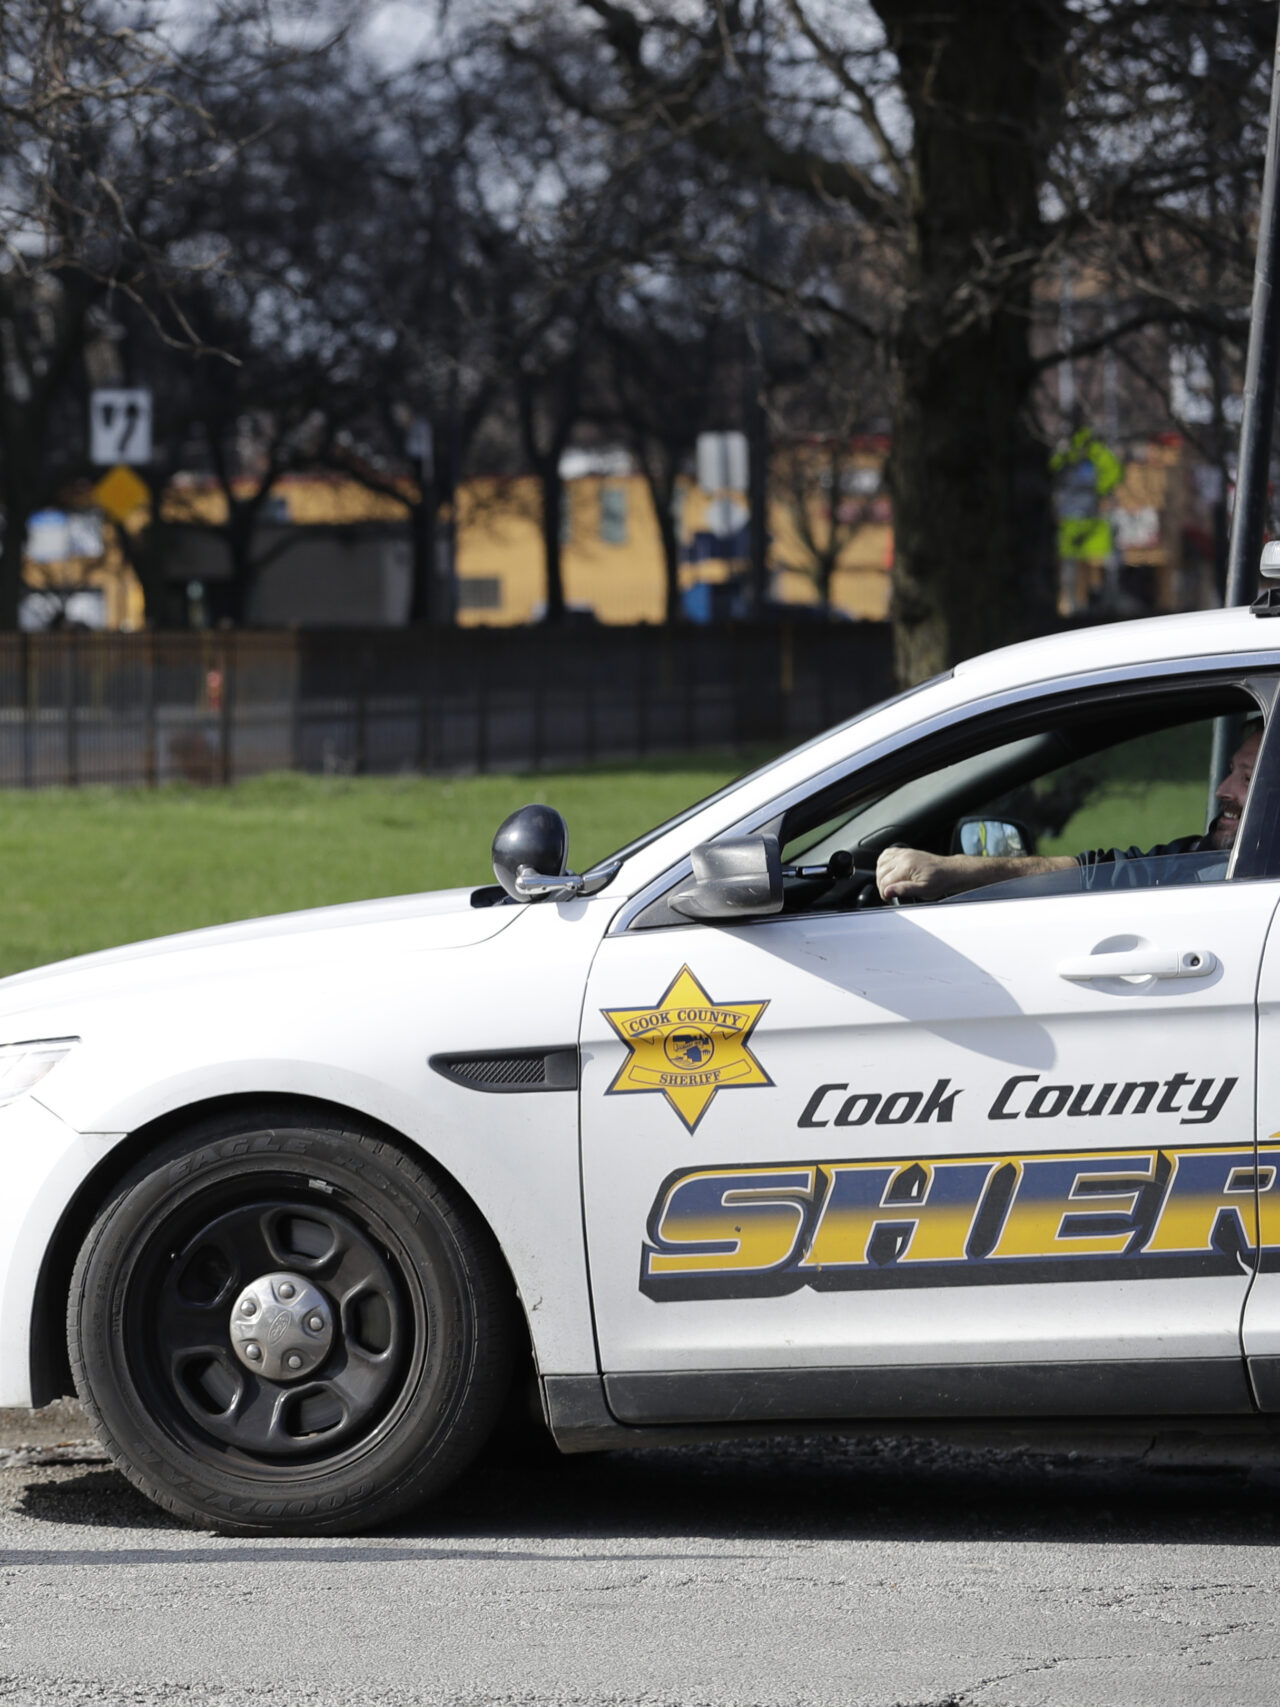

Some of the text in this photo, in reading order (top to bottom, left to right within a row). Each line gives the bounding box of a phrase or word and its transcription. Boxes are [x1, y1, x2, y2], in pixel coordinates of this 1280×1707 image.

[629, 1009, 743, 1032] COOK COUNTY
[659, 1070, 722, 1086] SHERIFF
[797, 1071, 1238, 1129] Cook County
[170, 1136, 313, 1183] EAGLE
